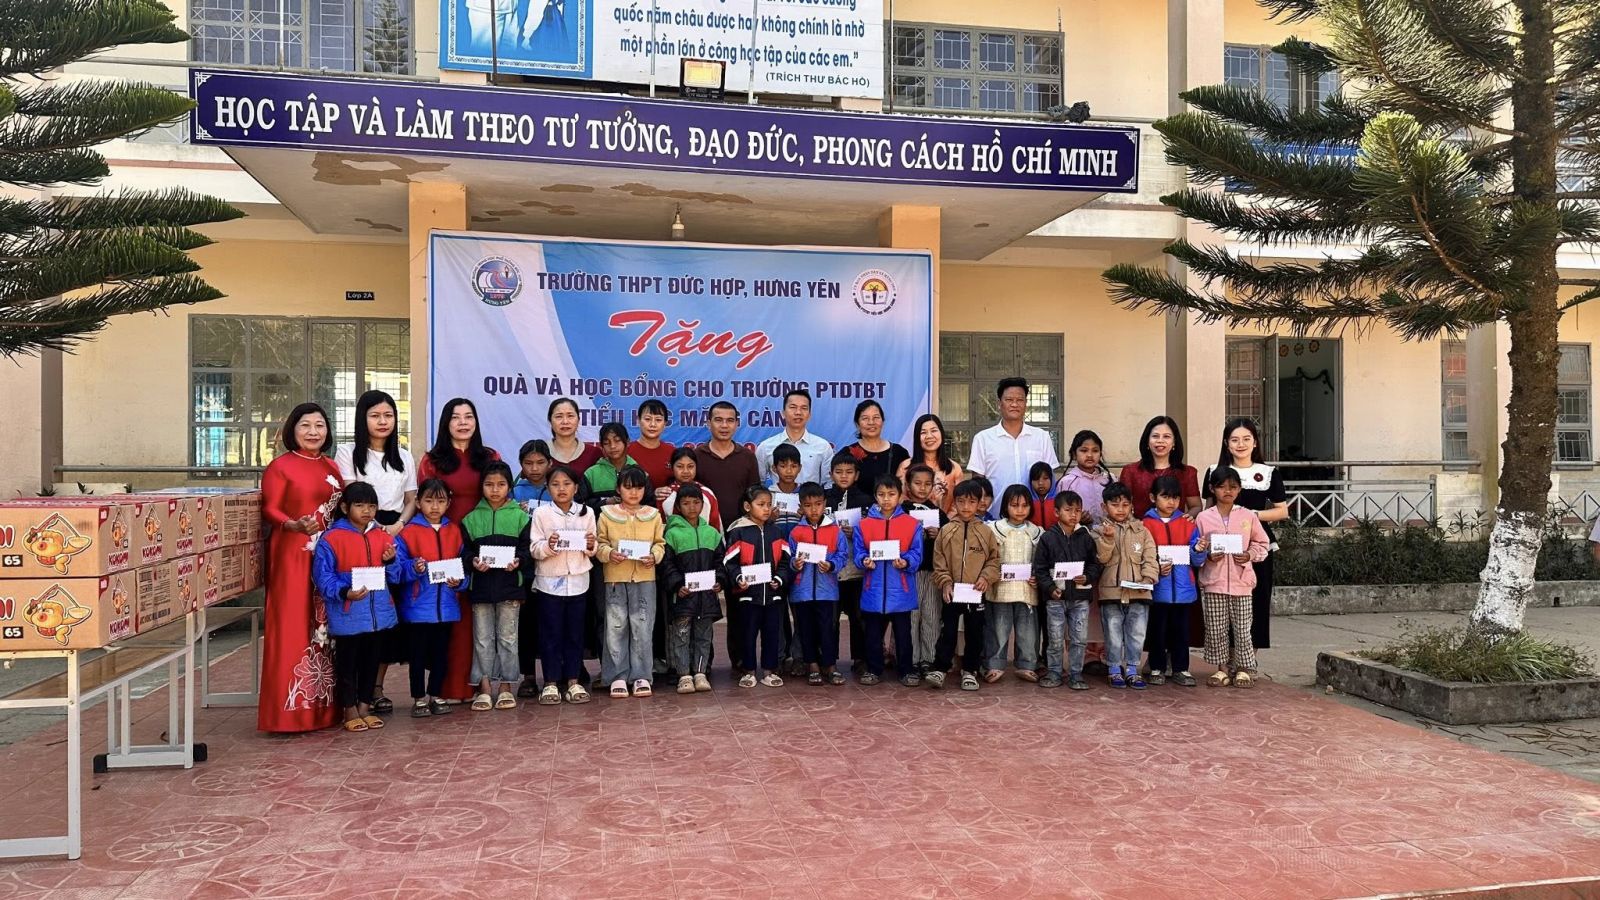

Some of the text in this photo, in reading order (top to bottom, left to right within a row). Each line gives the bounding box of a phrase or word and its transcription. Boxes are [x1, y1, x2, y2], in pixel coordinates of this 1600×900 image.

[614, 2, 644, 24] quốc
[646, 6, 672, 24] năm
[674, 8, 704, 28] châu
[706, 11, 735, 33] được
[761, 14, 796, 38] không
[798, 17, 829, 36] chính
[832, 19, 842, 37] là
[844, 19, 865, 38] nhờ
[620, 34, 643, 57] một
[645, 32, 675, 57] phần
[678, 38, 696, 57] lớn
[698, 38, 706, 58] ở
[708, 41, 737, 65] công
[739, 43, 761, 66] học
[764, 44, 783, 68] tập
[785, 44, 806, 66] của
[808, 47, 830, 67] các
[765, 72, 801, 83] (TRÍCH
[803, 74, 826, 84] THƯ
[827, 74, 850, 86] BÁC
[214, 92, 1118, 177] HỌC TẬP VÀ LÀM THEO TƯ TƯỞNG, ĐẠO ĐỨC, PHONG CÁCH HỒ CHÍ MINH
[536, 269, 613, 293] TRƯỜNG
[617, 275, 663, 294] THPT
[667, 274, 705, 296] ĐỨC
[710, 276, 748, 300] HỢP,
[753, 278, 801, 298] HƯNG
[807, 278, 841, 299] YÊN
[608, 309, 773, 370] Tặng
[483, 372, 529, 396] QUÀ
[535, 374, 563, 396] VÀ
[569, 378, 613, 400] HỌC
[619, 372, 677, 397] BỔNG
[684, 380, 724, 398] CHO
[816, 382, 887, 399] PTDTBT
[579, 401, 625, 427] TIỂU
[747, 406, 786, 428] CÀN
[4, 555, 21, 566] 65
[5, 627, 21, 638] 65
